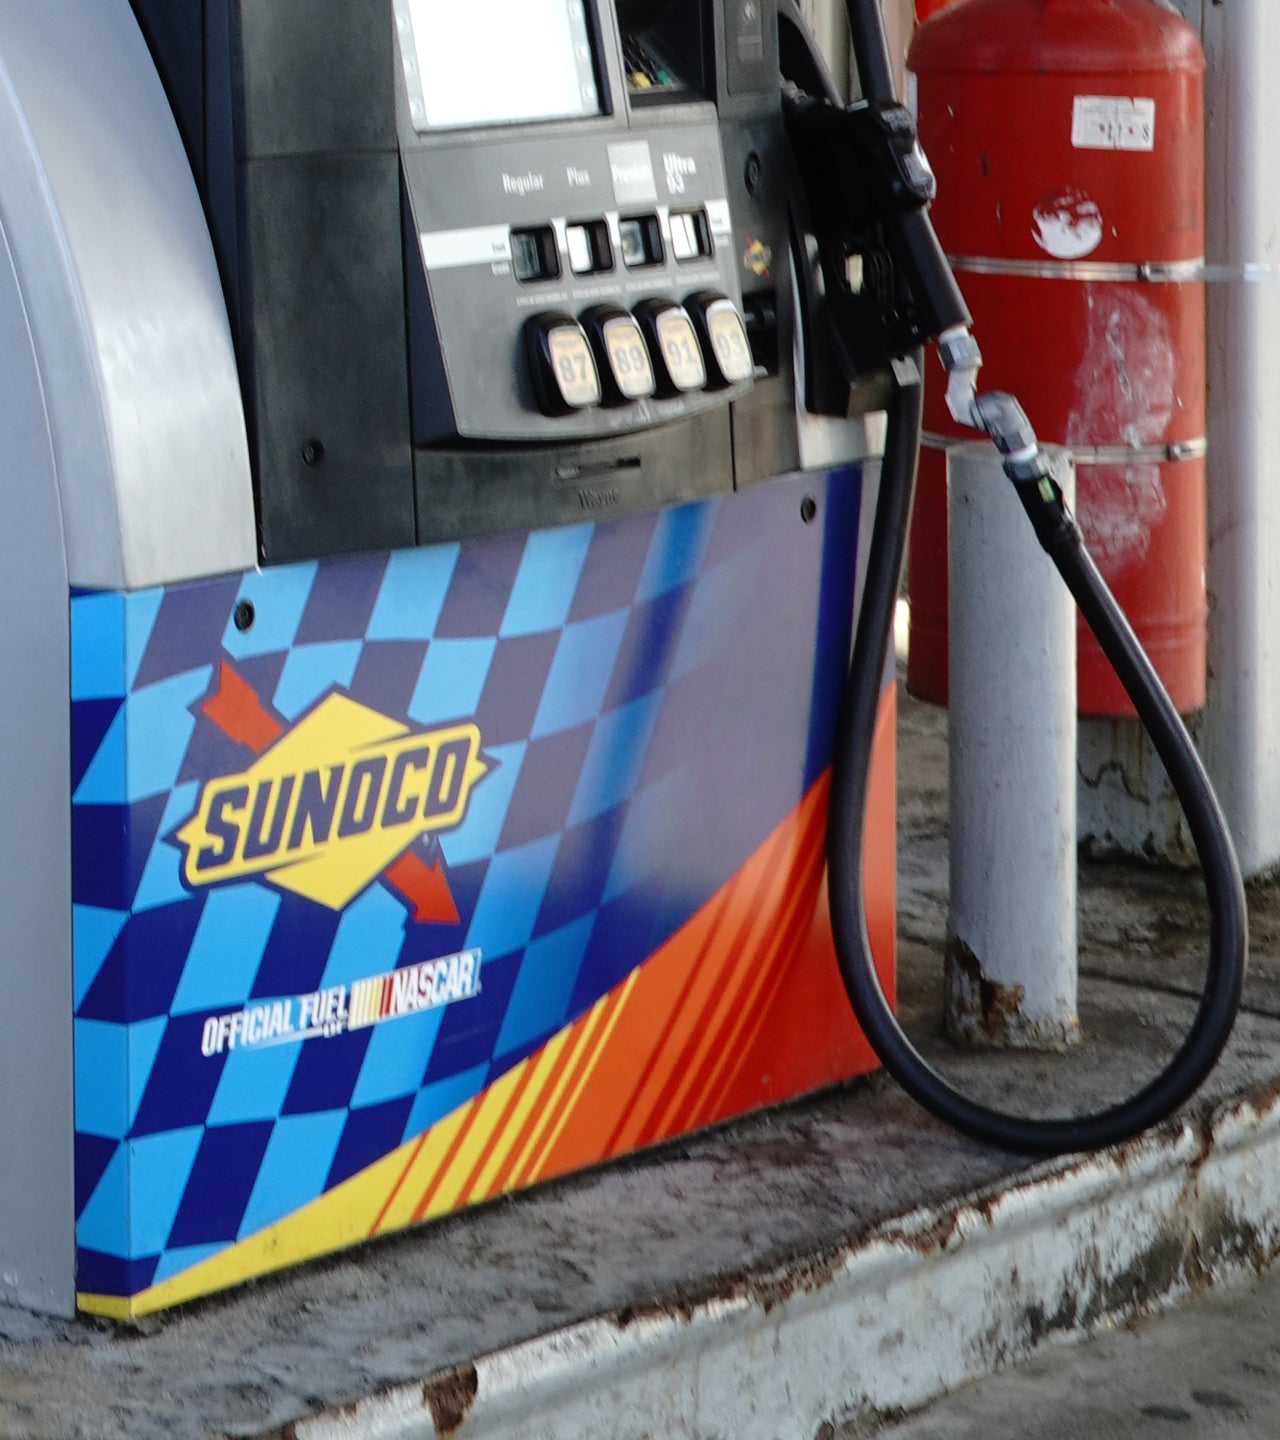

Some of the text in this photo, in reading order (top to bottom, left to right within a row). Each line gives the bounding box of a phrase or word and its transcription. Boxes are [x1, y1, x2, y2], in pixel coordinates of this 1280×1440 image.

[566, 166, 590, 187] Plus
[662, 152, 697, 175] Ultra
[501, 170, 545, 196] Regular
[615, 345, 644, 375] 89
[666, 336, 697, 368] 91
[558, 353, 587, 384] 87
[196, 735, 472, 871] SUNOCO
[201, 996, 293, 1057] OFFICIAL
[299, 986, 350, 1027] FUEL
[390, 951, 478, 1015] NASCAR
